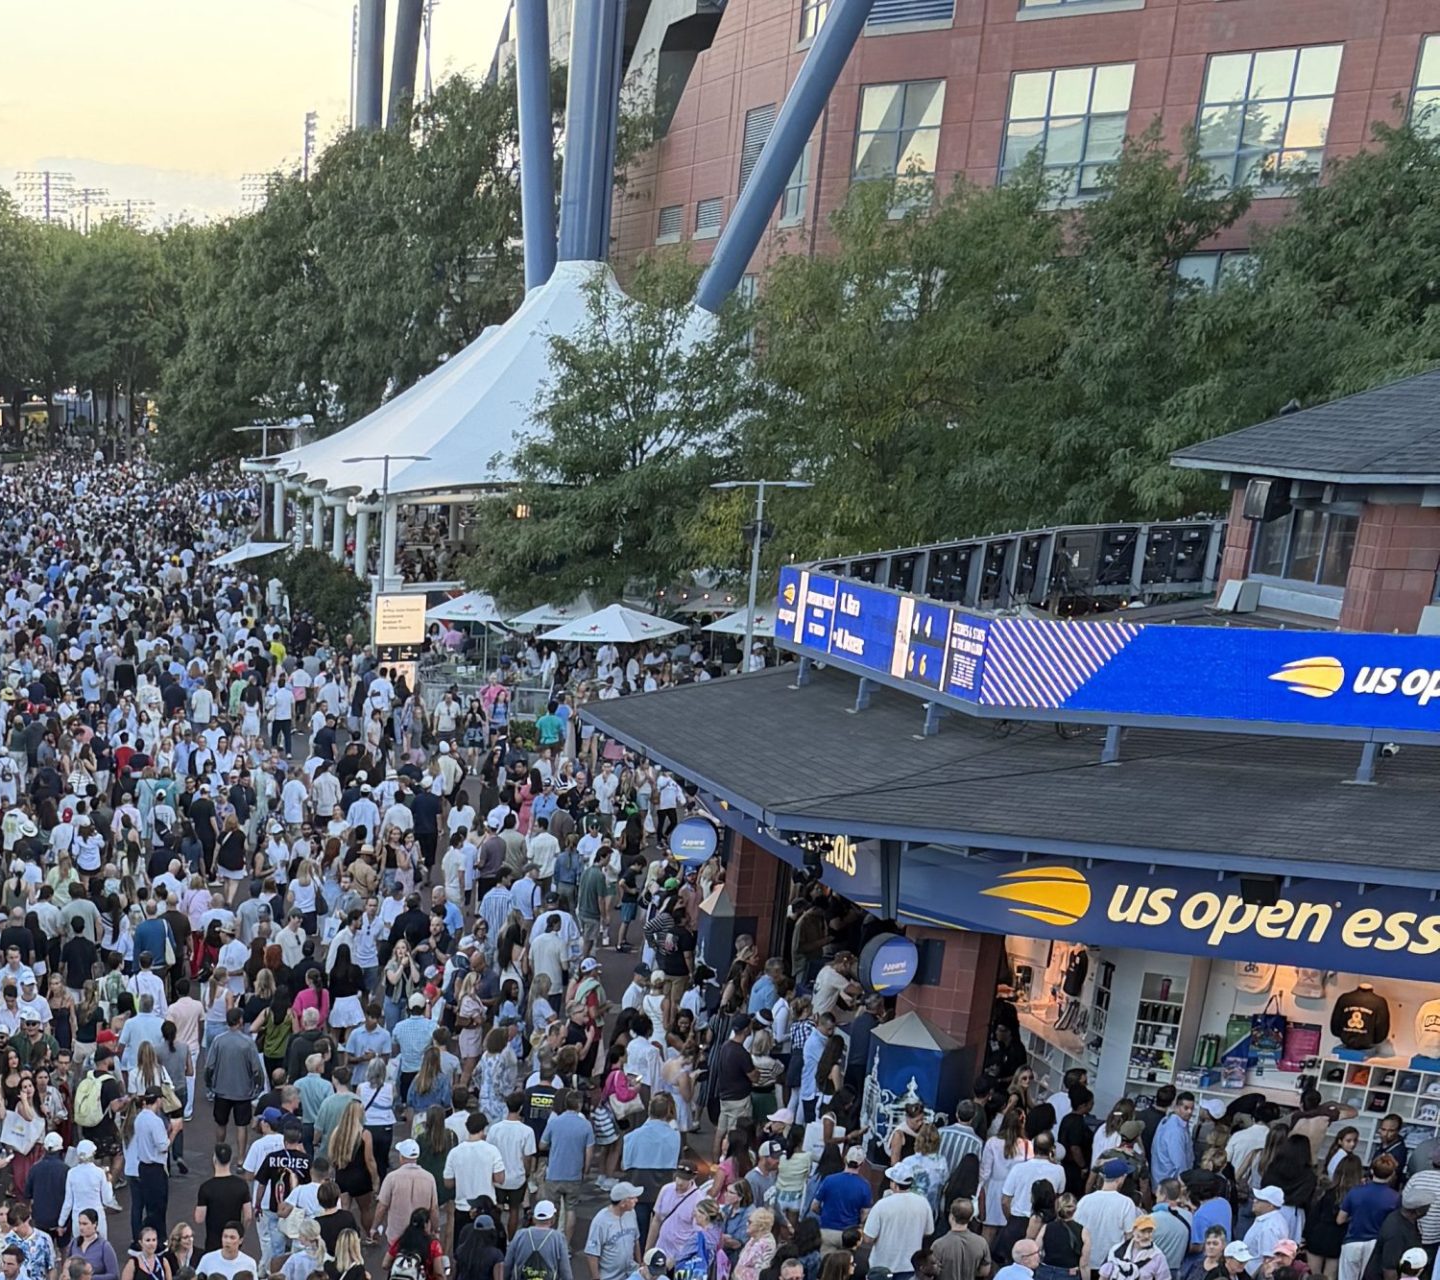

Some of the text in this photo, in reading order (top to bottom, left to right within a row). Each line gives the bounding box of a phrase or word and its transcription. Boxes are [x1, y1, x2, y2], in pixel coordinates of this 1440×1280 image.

[907, 650, 927, 676] 6 6
[1353, 666, 1402, 695] us
[1107, 885, 1178, 926] us
[1179, 891, 1333, 946] open
